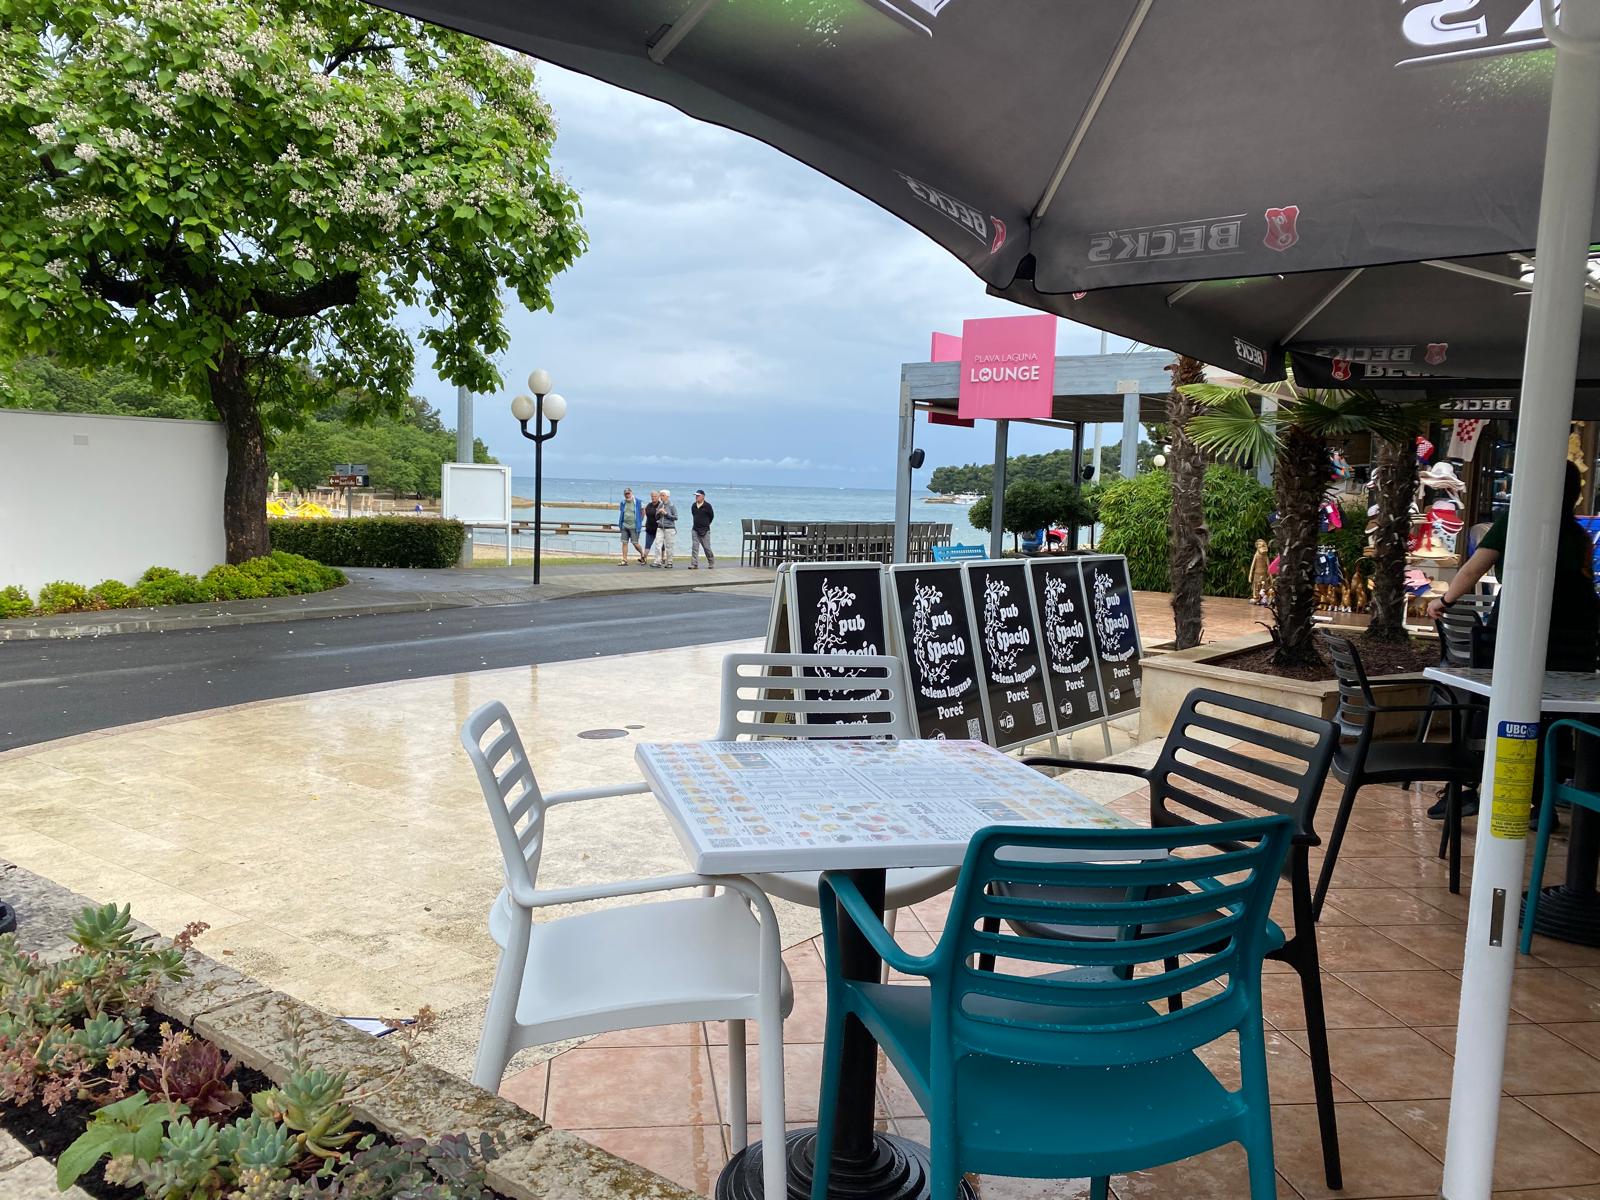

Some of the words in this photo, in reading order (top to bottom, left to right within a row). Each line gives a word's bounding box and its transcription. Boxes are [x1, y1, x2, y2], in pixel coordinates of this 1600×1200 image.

[975, 354, 1000, 363] PLAVA
[1002, 353, 1038, 362] LAGUNA
[970, 365, 1040, 382] LOUNGE
[1058, 598, 1074, 616] pub
[1106, 592, 1120, 609] pub
[930, 610, 952, 630] pub
[1000, 603, 1018, 621] pub
[838, 614, 865, 636] pub
[992, 672, 1014, 684] zelena
[1014, 664, 1036, 683] laguna
[1113, 664, 1130, 678] Poreč
[920, 685, 946, 698] zelena
[947, 677, 972, 698] laguna
[1065, 676, 1084, 692] Poreč
[1006, 686, 1030, 703] Poreč
[938, 701, 964, 720] Poreč
[1506, 723, 1527, 734] UBC
